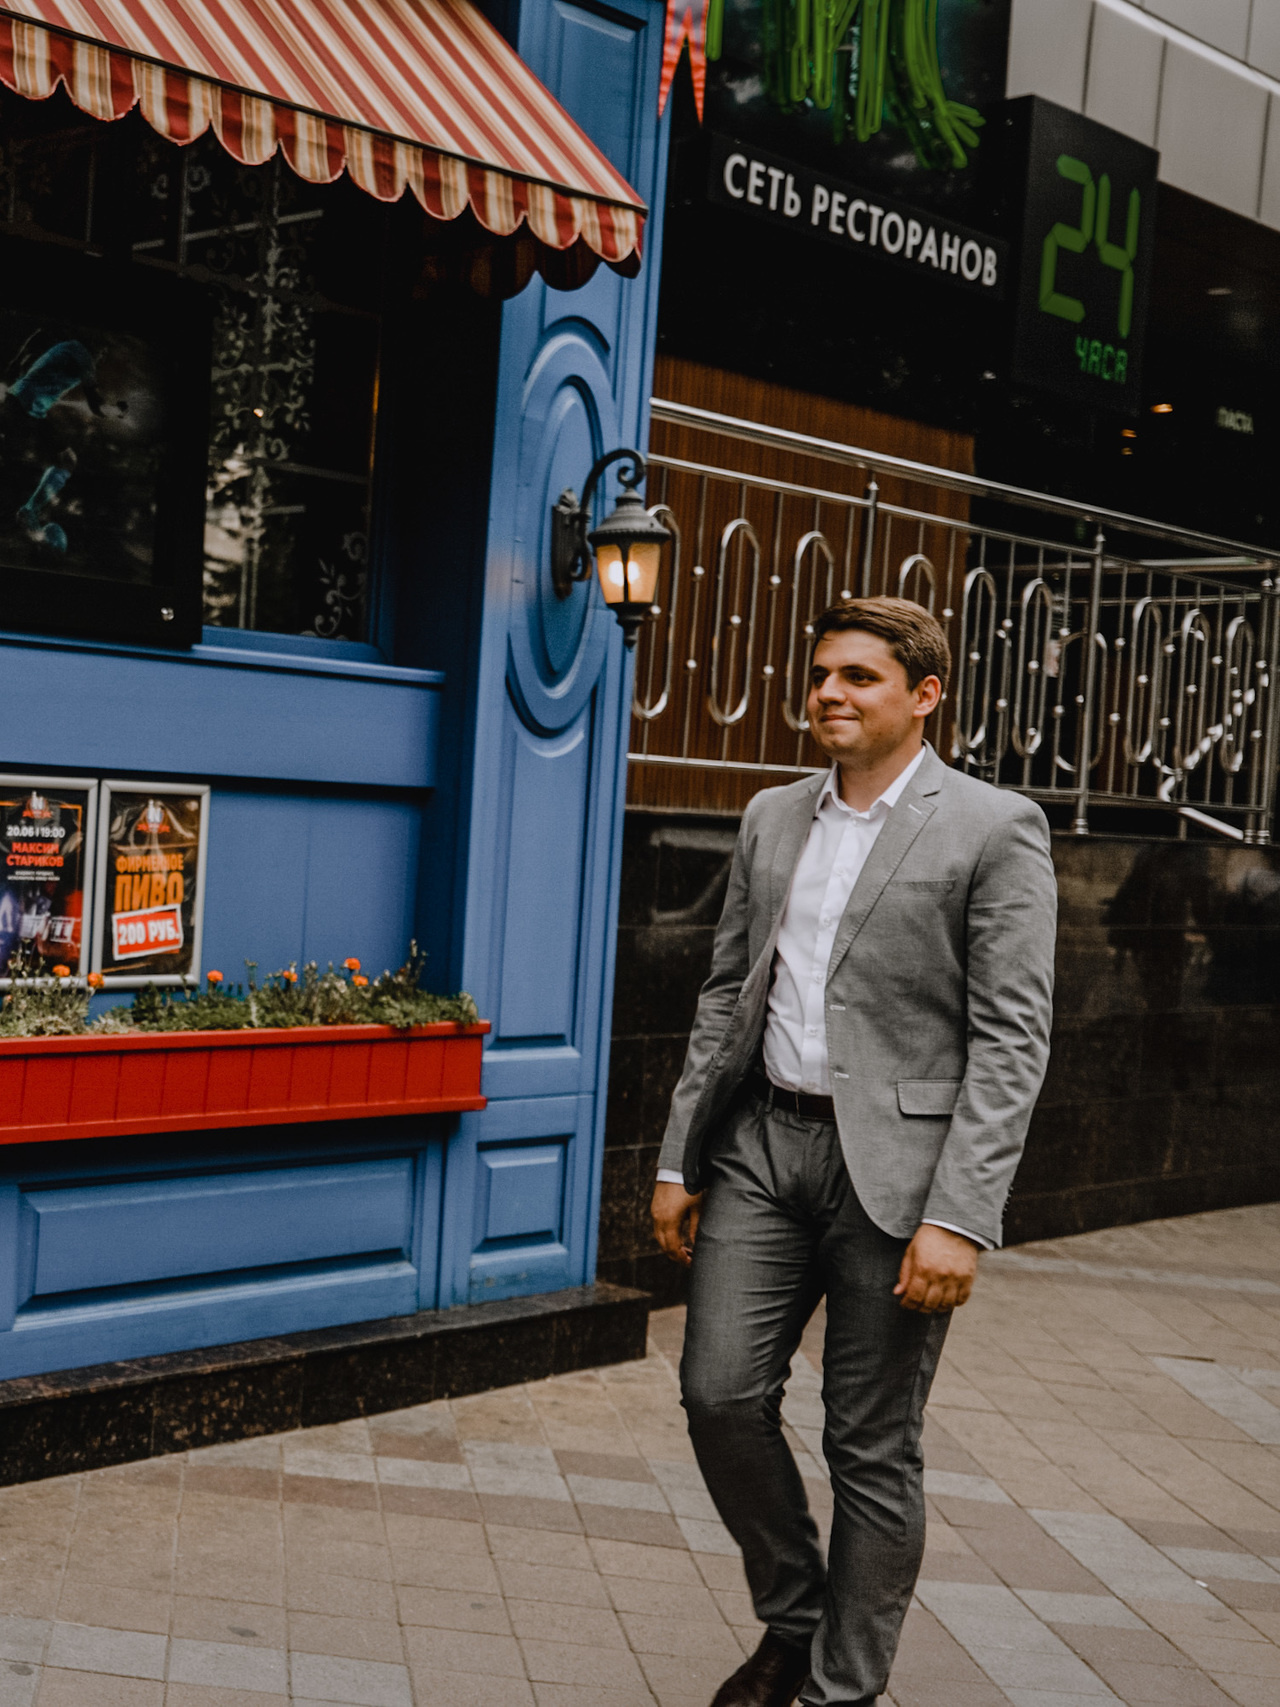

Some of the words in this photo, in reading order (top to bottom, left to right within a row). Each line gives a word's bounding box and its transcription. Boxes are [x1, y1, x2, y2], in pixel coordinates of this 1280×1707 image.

[723, 153, 801, 217] СЕТЬ
[811, 184, 998, 286] РЕСТОРАНОВ
[1039, 154, 1141, 339] 24
[6, 825, 34, 837] 20.06
[41, 827, 66, 838] 19:00
[12, 842, 60, 854] МАКСИМ
[6, 854, 64, 867] СТАРИКОВ
[116, 854, 185, 873] ФИРМЕННОЕ
[114, 871, 185, 911] ПИВО
[118, 921, 146, 946] 200
[147, 918, 181, 943] РУБ.
